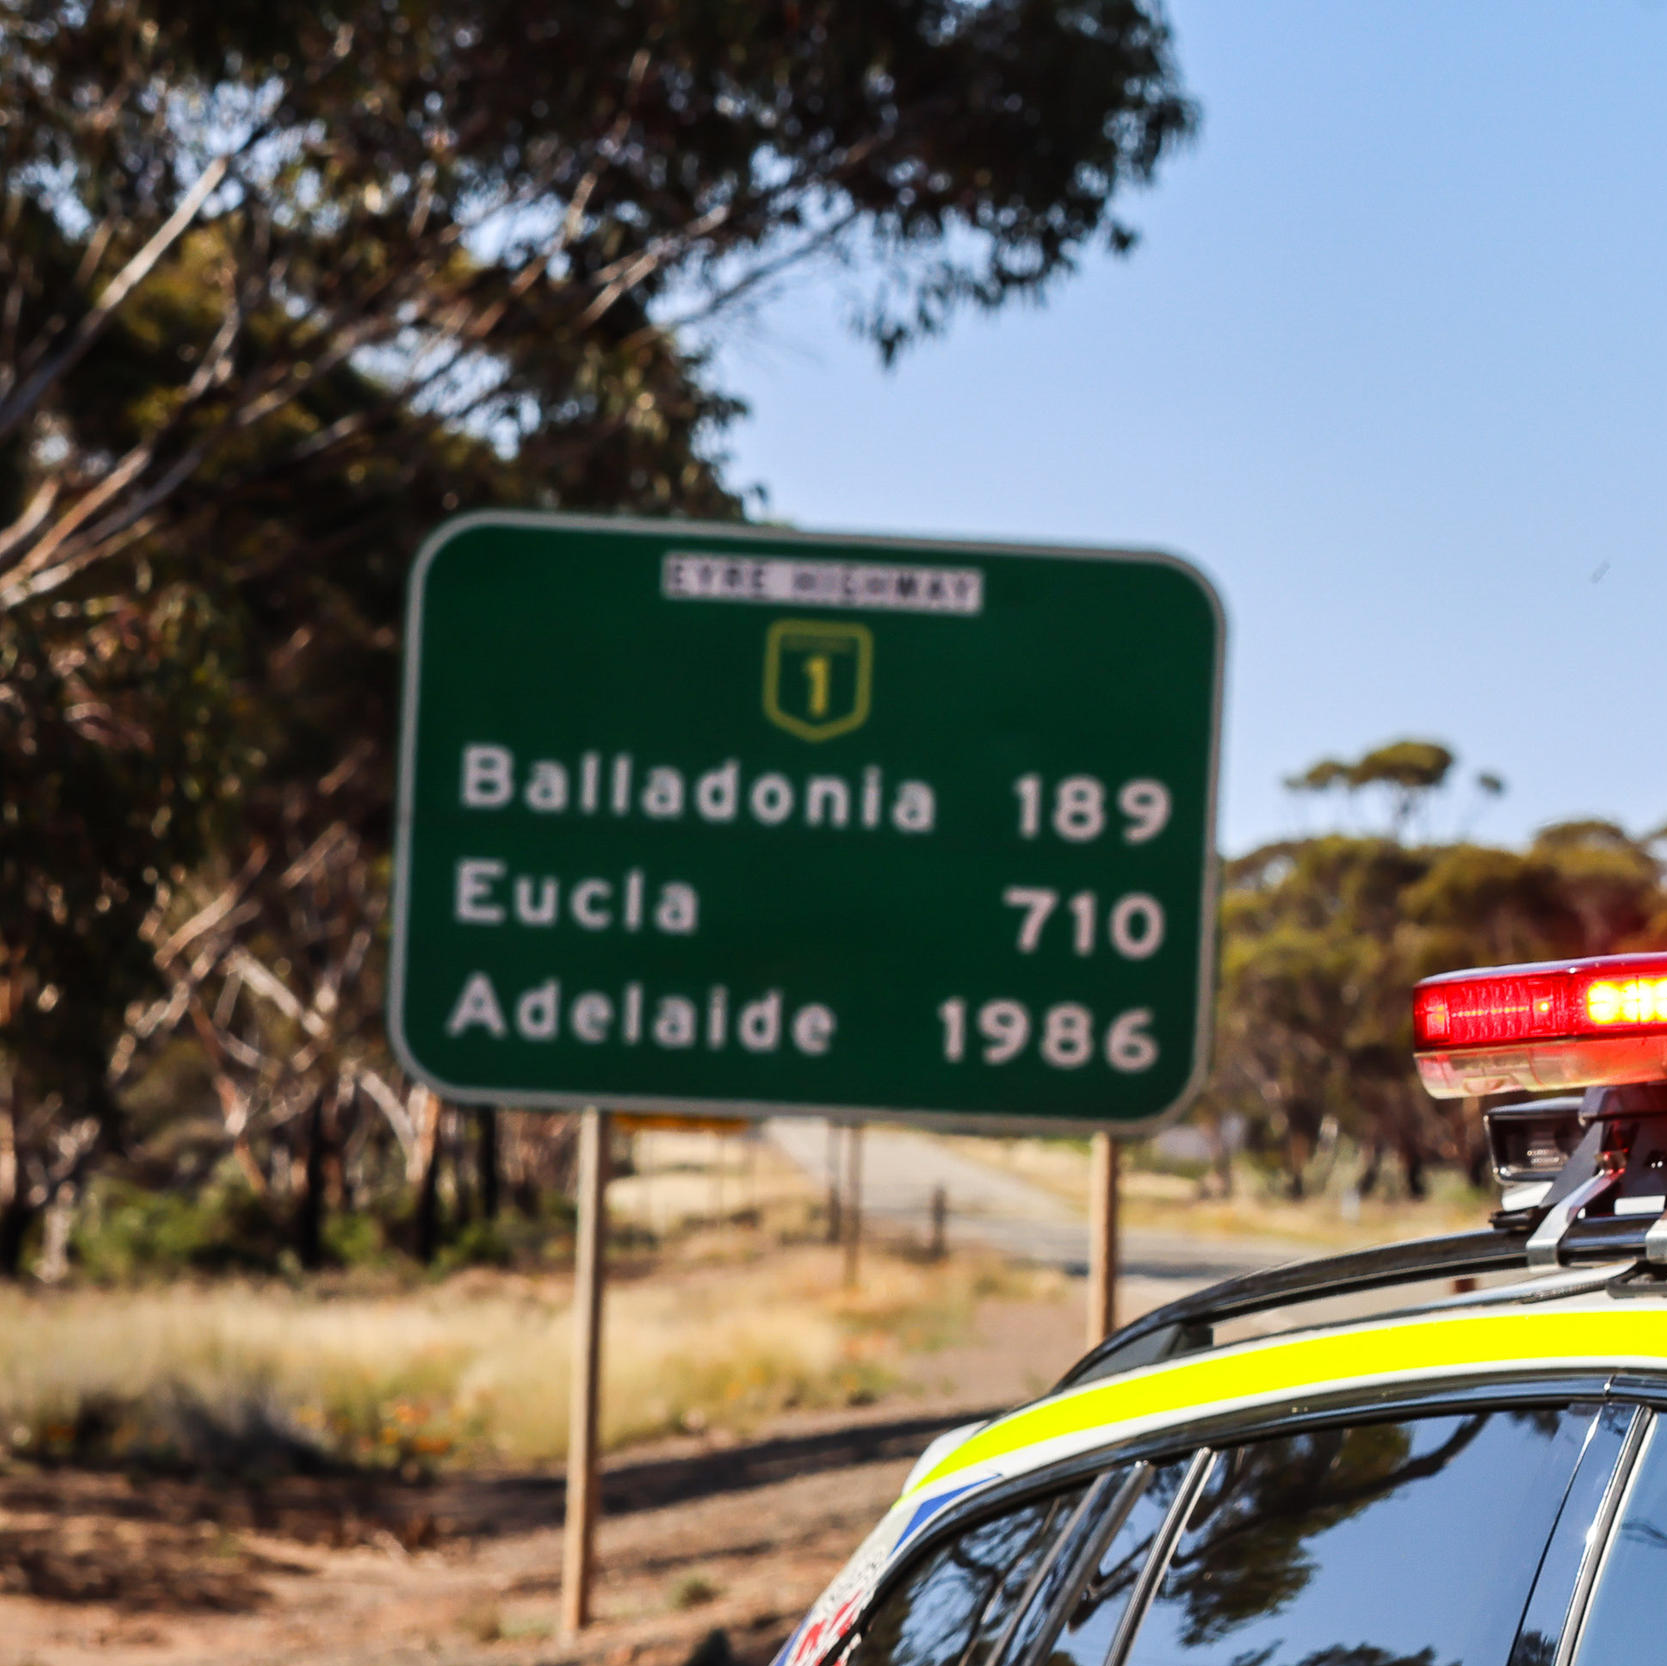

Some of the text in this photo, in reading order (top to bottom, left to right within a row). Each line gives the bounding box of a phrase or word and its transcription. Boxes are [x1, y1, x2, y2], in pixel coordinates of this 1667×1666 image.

[805, 655, 830, 717] 1
[461, 744, 1172, 844] Balladonia 189
[455, 858, 1166, 960] Eucla 710
[447, 972, 1158, 1073] Adelaide 1986
